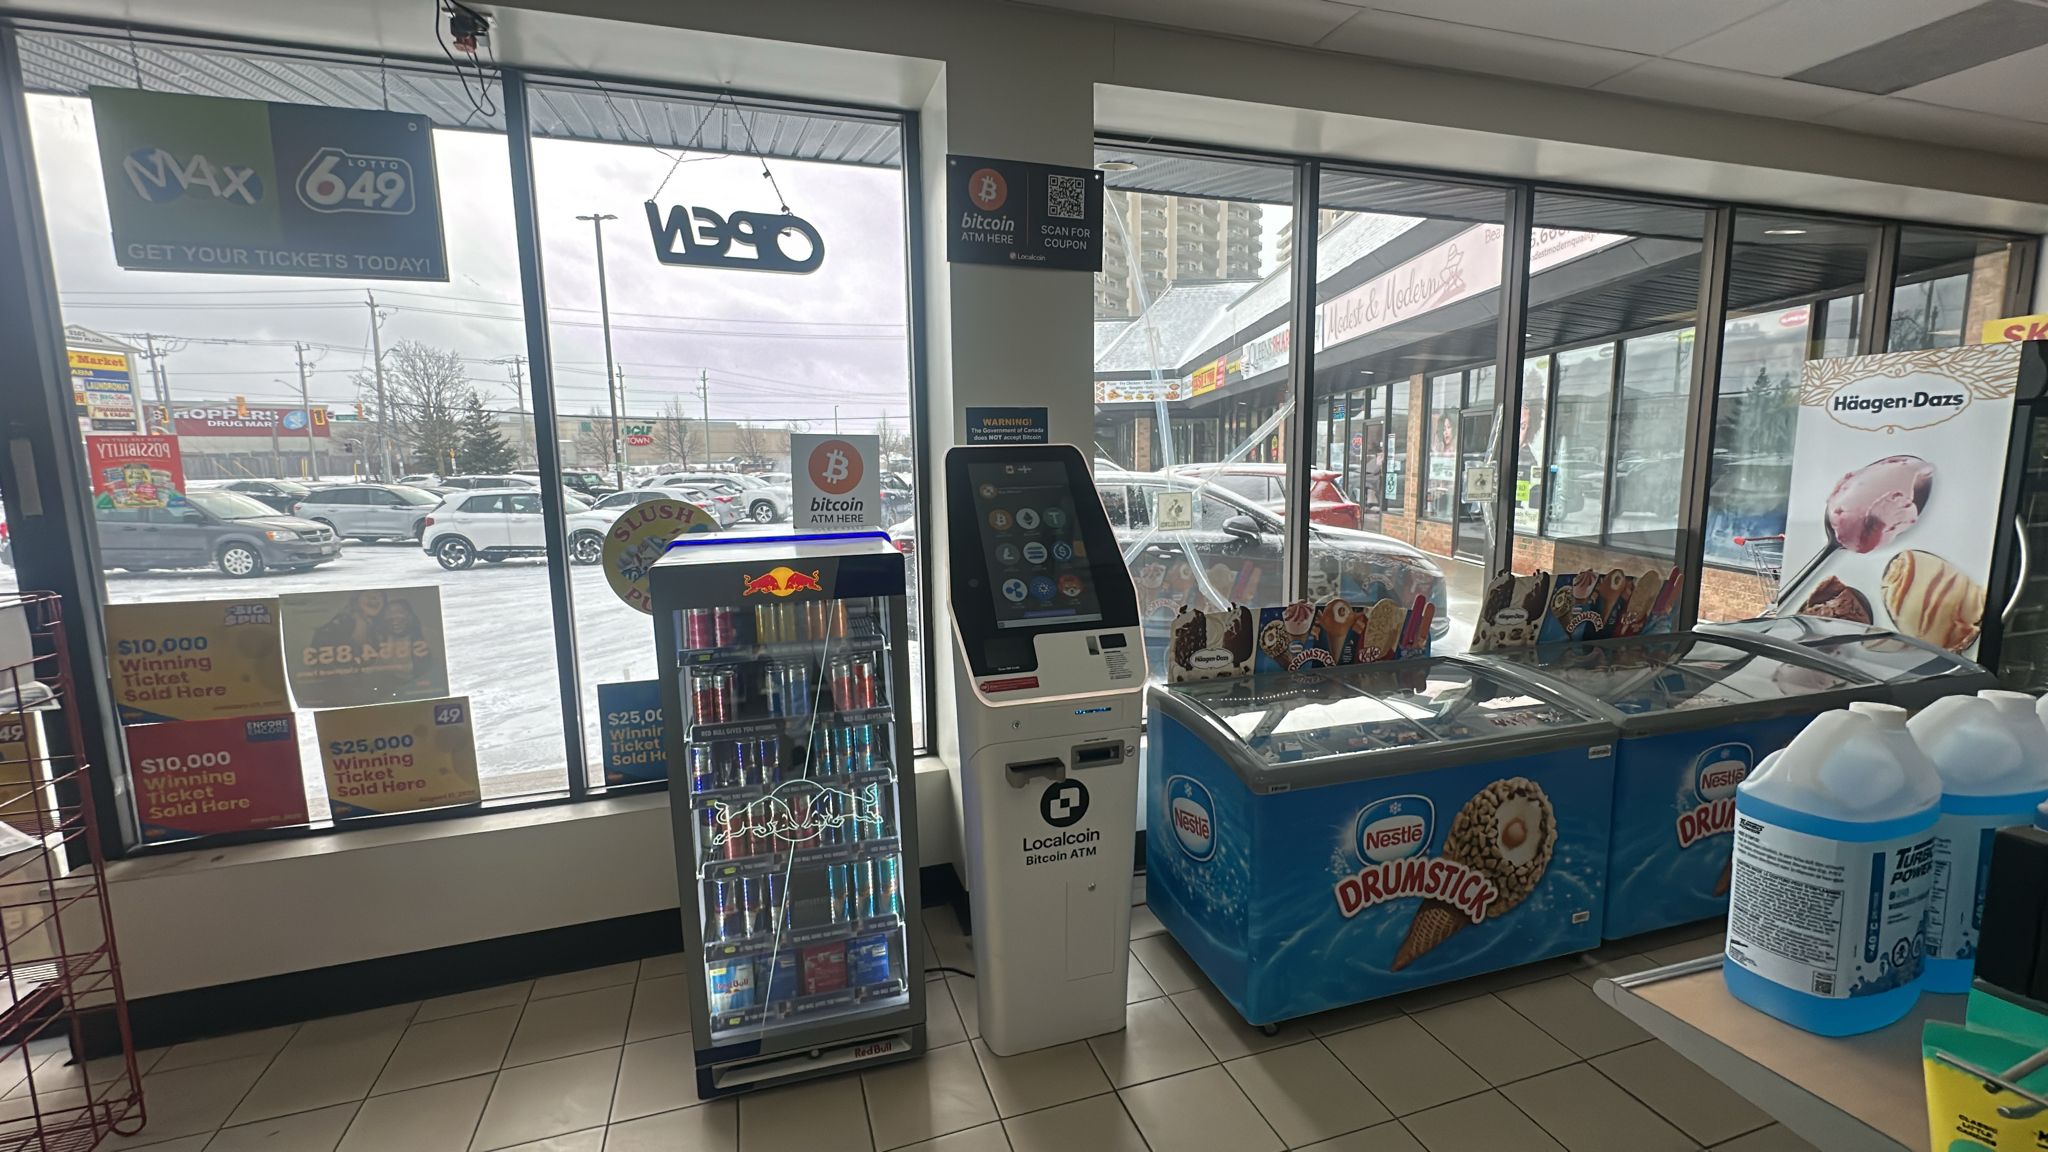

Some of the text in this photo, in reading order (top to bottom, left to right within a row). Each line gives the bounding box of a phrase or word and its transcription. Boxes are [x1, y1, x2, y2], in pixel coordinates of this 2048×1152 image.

[348, 159, 399, 170] LOTTO
[305, 155, 405, 209] 649
[961, 211, 1015, 232] bitcoin
[961, 231, 1014, 245] ATM HERE
[1041, 225, 1091, 239] SCAN FOR
[1484, 228, 1504, 245] Bea
[1044, 239, 1087, 250] COUPON
[127, 243, 431, 273] GET YOUR TICKETS TODAY!
[1327, 268, 1441, 342] Modest & Modern
[77, 355, 125, 367] Market
[1833, 391, 1964, 414] Häagen-Dazs
[982, 418, 1033, 426] WARNING!
[810, 497, 864, 511] bitcoin
[613, 504, 695, 542] SLUSH
[811, 514, 864, 523] ATM HERE
[235, 605, 265, 615] BIG
[118, 636, 208, 656] $10,000
[118, 655, 212, 673] Winning
[121, 671, 190, 688] Ticket
[124, 685, 226, 702] Sold Here
[246, 719, 288, 729] ENCORE
[437, 708, 461, 723] 49
[329, 734, 414, 756] $25,000
[610, 738, 660, 753] Ticket
[140, 751, 231, 774] $10,000
[332, 753, 414, 771] Winning
[612, 751, 647, 766] Sold
[143, 770, 236, 790] Winning
[334, 768, 395, 785] Ticket
[1702, 768, 1744, 789] Nestlé
[146, 786, 214, 805] Ticket
[337, 778, 426, 797] Sold Here
[149, 798, 250, 820] Sold Here
[1174, 806, 1210, 841] Nestlé
[1023, 828, 1100, 852] Localcoin
[1366, 822, 1423, 851] Nestlé
[1026, 846, 1097, 866] Bitcoin ATM
[1338, 860, 1495, 920] DRUMSTICK
